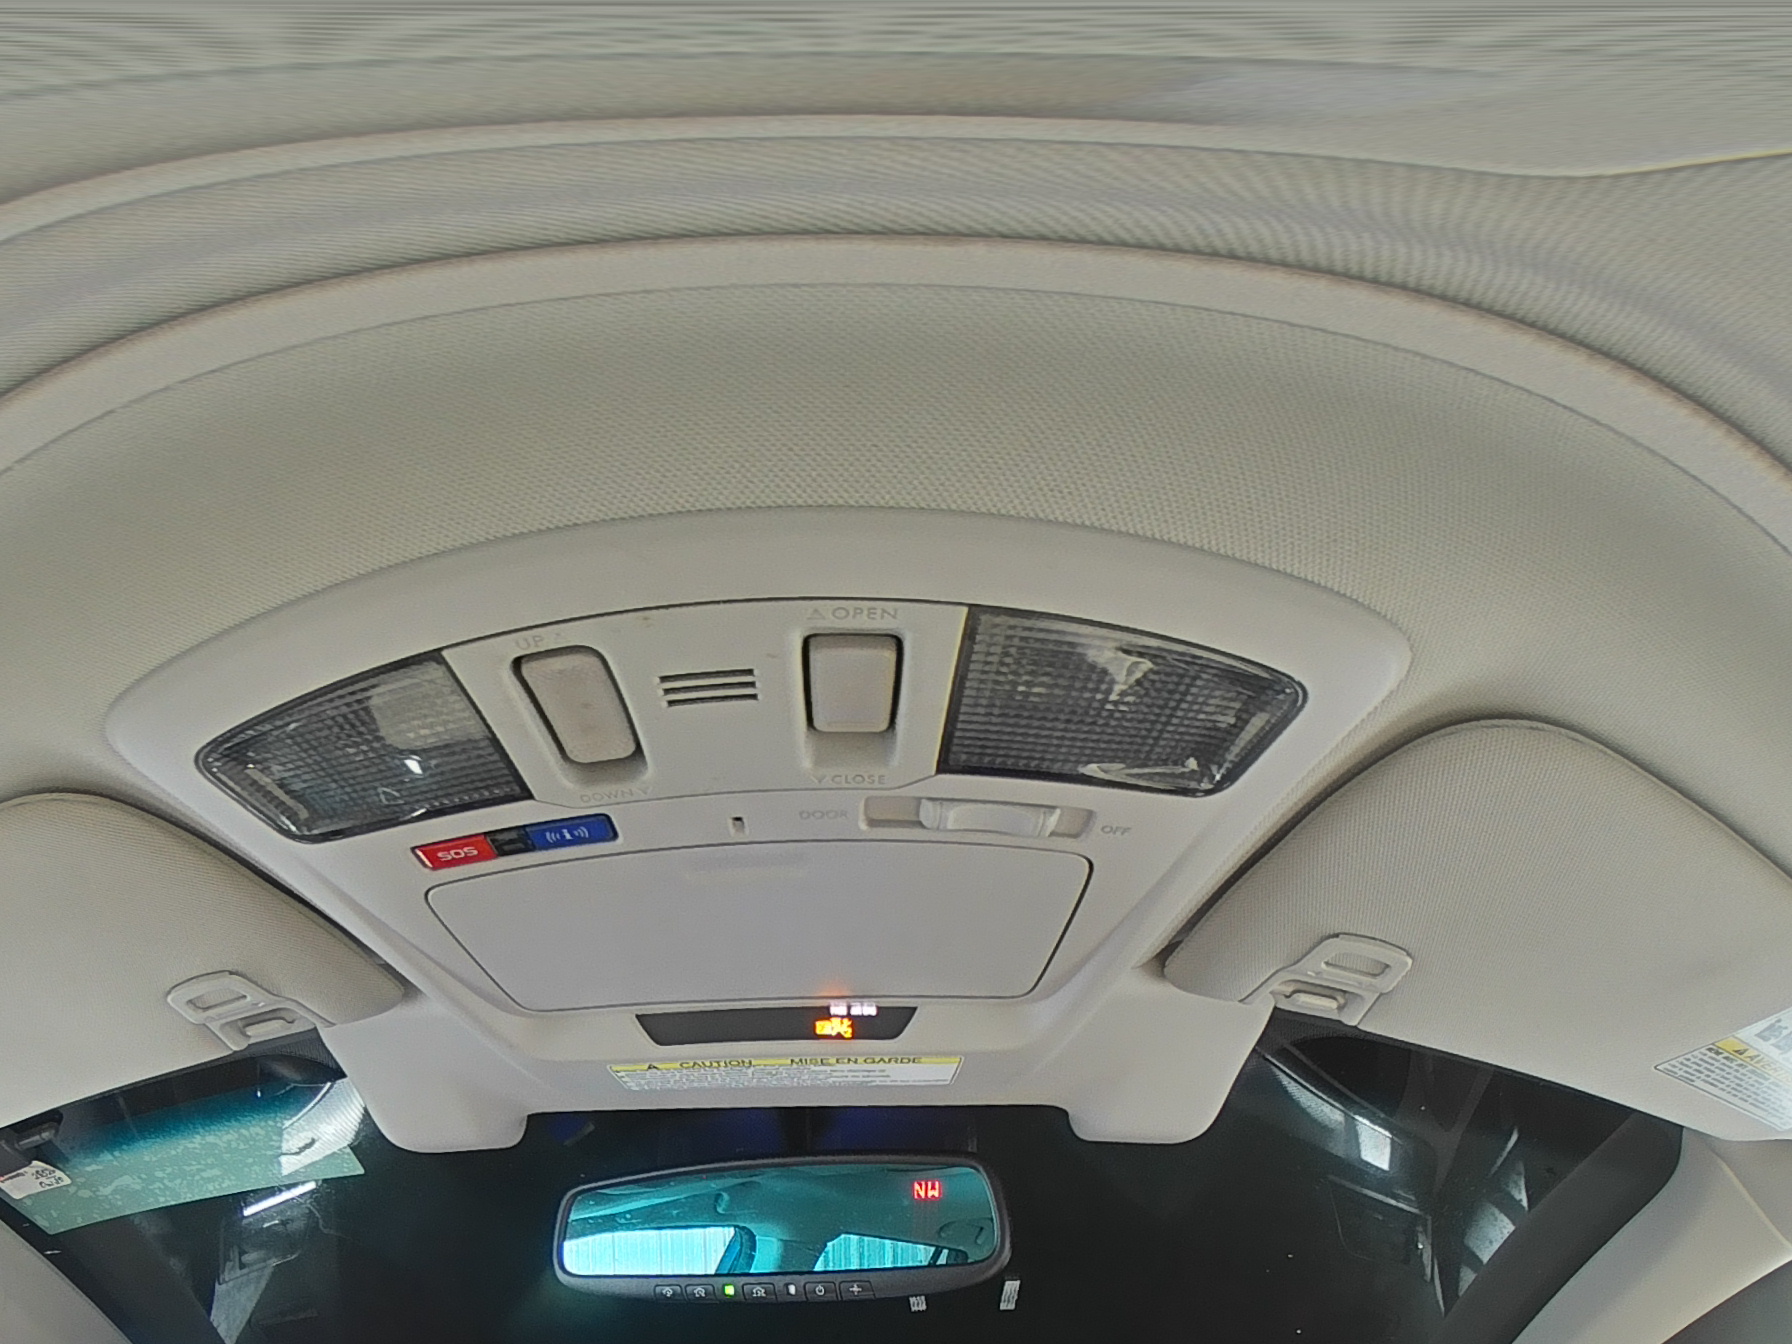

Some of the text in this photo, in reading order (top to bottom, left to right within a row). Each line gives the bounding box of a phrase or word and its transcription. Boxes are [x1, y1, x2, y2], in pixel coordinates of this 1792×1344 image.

[831, 606, 898, 620] OPEN
[515, 634, 544, 650] UP
[831, 773, 886, 786] CLOSE
[580, 787, 634, 804] DOWN
[798, 809, 849, 821] DOOR
[1100, 824, 1132, 836] OFF
[437, 846, 479, 862] SOS
[679, 1056, 922, 1069] CAUTION MISE EN GARDE
[913, 1180, 941, 1199] NW
